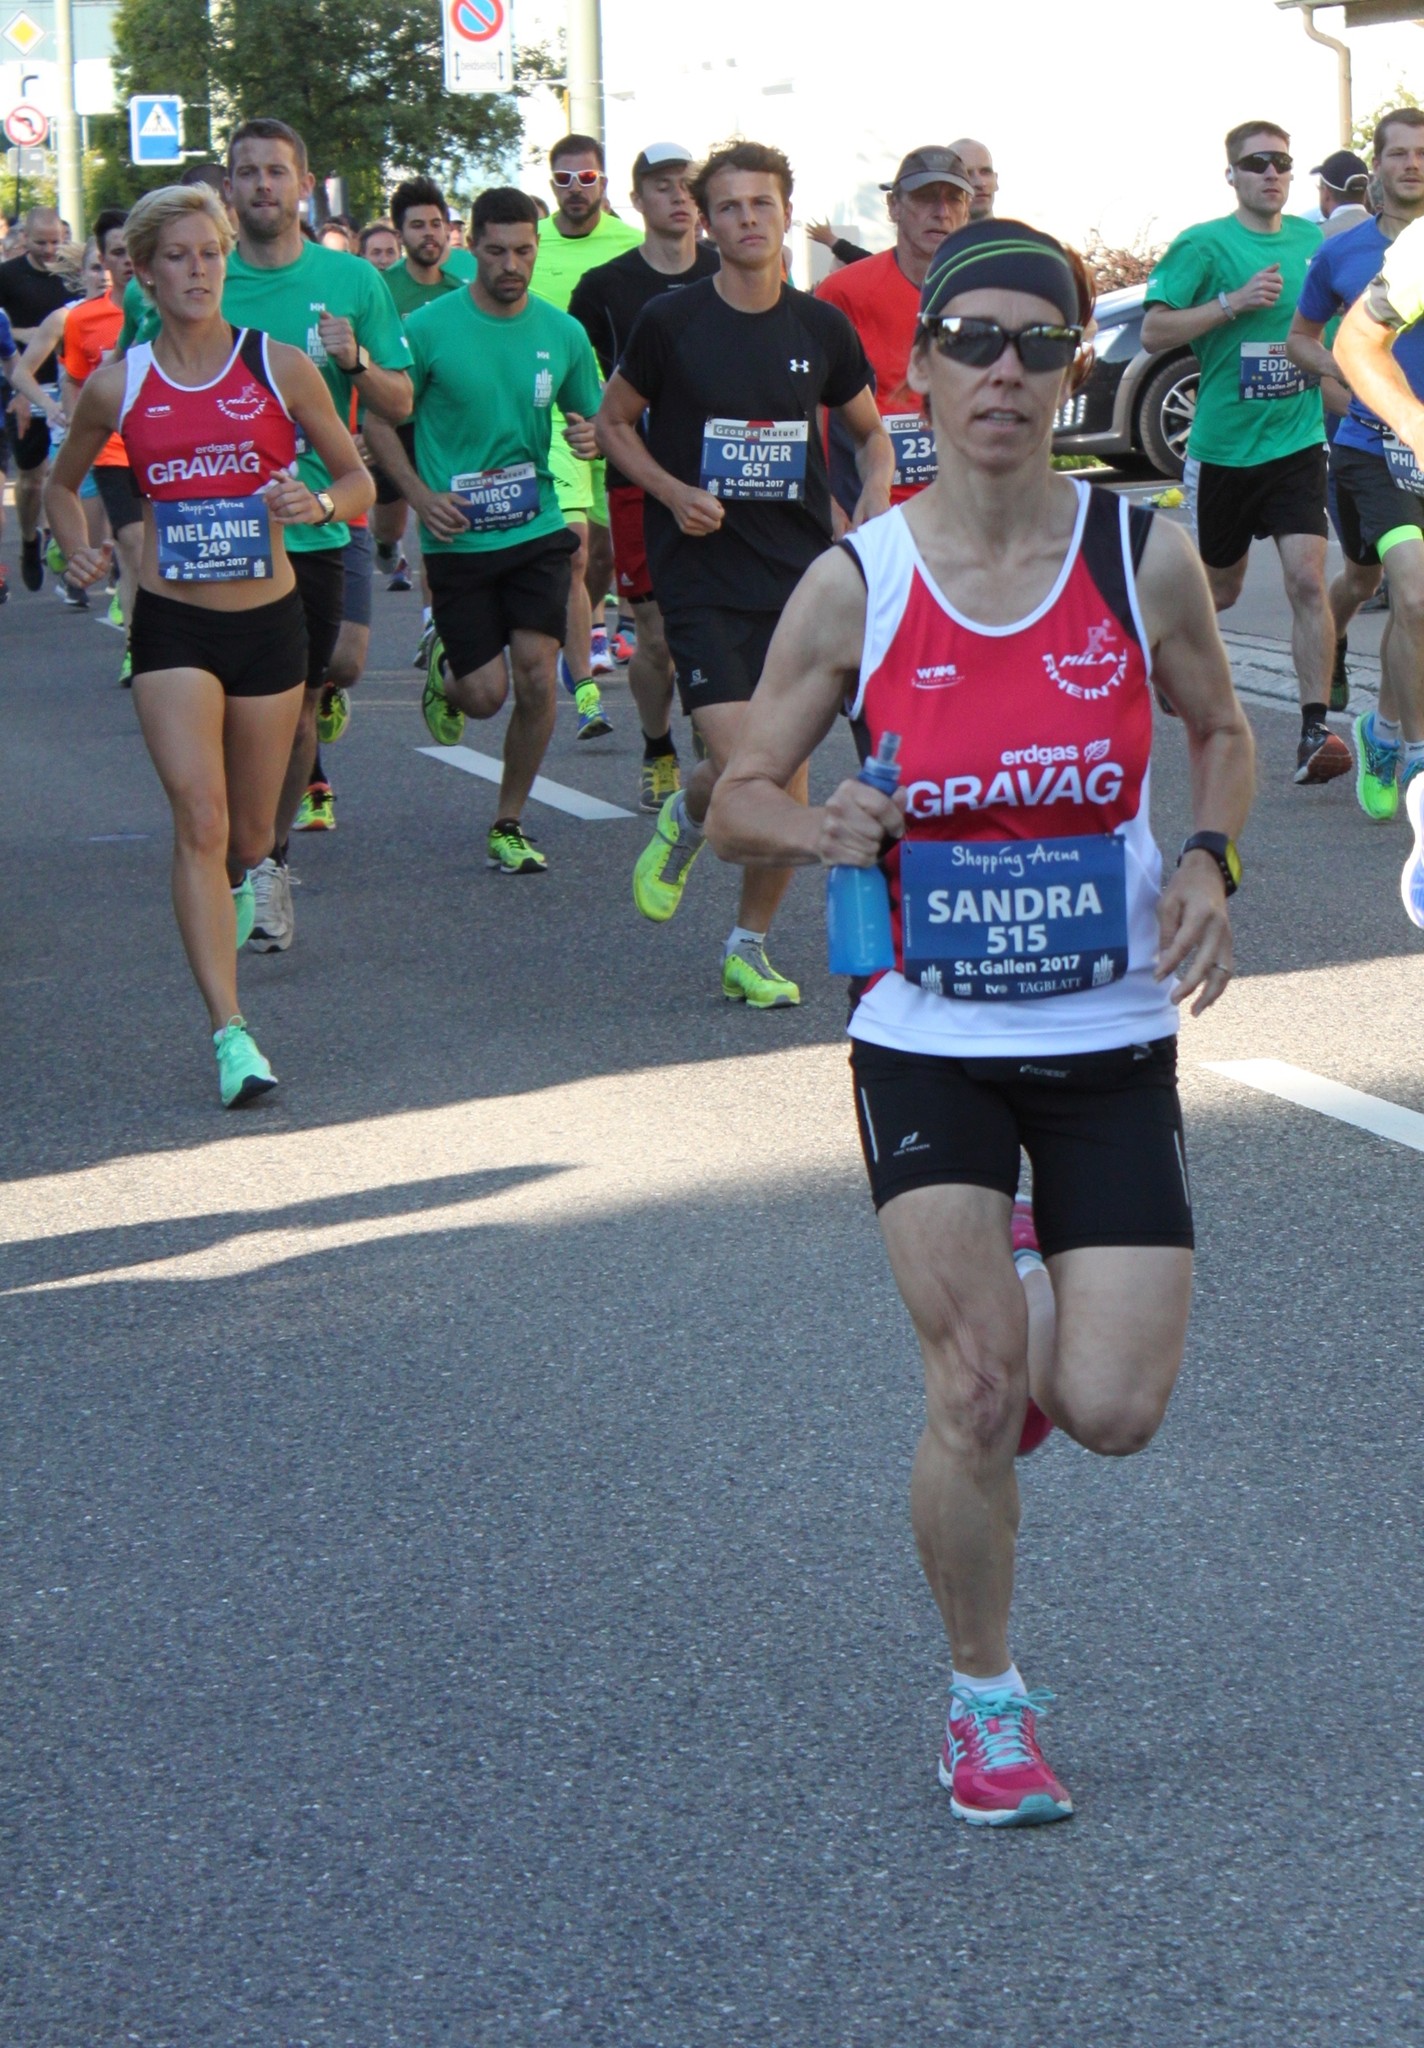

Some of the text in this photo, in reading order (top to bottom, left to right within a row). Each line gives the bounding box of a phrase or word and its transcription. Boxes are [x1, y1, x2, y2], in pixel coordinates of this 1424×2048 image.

[1270, 371, 1289, 382] 171
[716, 425, 799, 438] Groupe Mutuel
[195, 441, 236, 454] erdgas
[722, 443, 792, 462] OLIVER
[147, 452, 260, 485] GRAVAG
[742, 463, 770, 477] 651
[906, 466, 916, 474] St.
[725, 478, 737, 486] St.
[738, 479, 765, 487] Gallen
[470, 484, 522, 506] MIRCO
[178, 498, 245, 517] Shopping Arena
[486, 501, 511, 514] 439
[166, 520, 260, 543] MELANIE
[197, 540, 231, 558] 249
[184, 557, 248, 570] St. Gallen 2017
[1042, 648, 1128, 700] RHEINTAL
[1001, 744, 1078, 765] erdgas
[905, 761, 1124, 820] GRAVAG
[951, 844, 1080, 877] Shopping Arena
[927, 882, 1103, 924] SANDRA
[987, 924, 1047, 955] 515
[954, 955, 1081, 976] St. Gallen 2017
[1017, 977, 1082, 994] TAGBLATT
